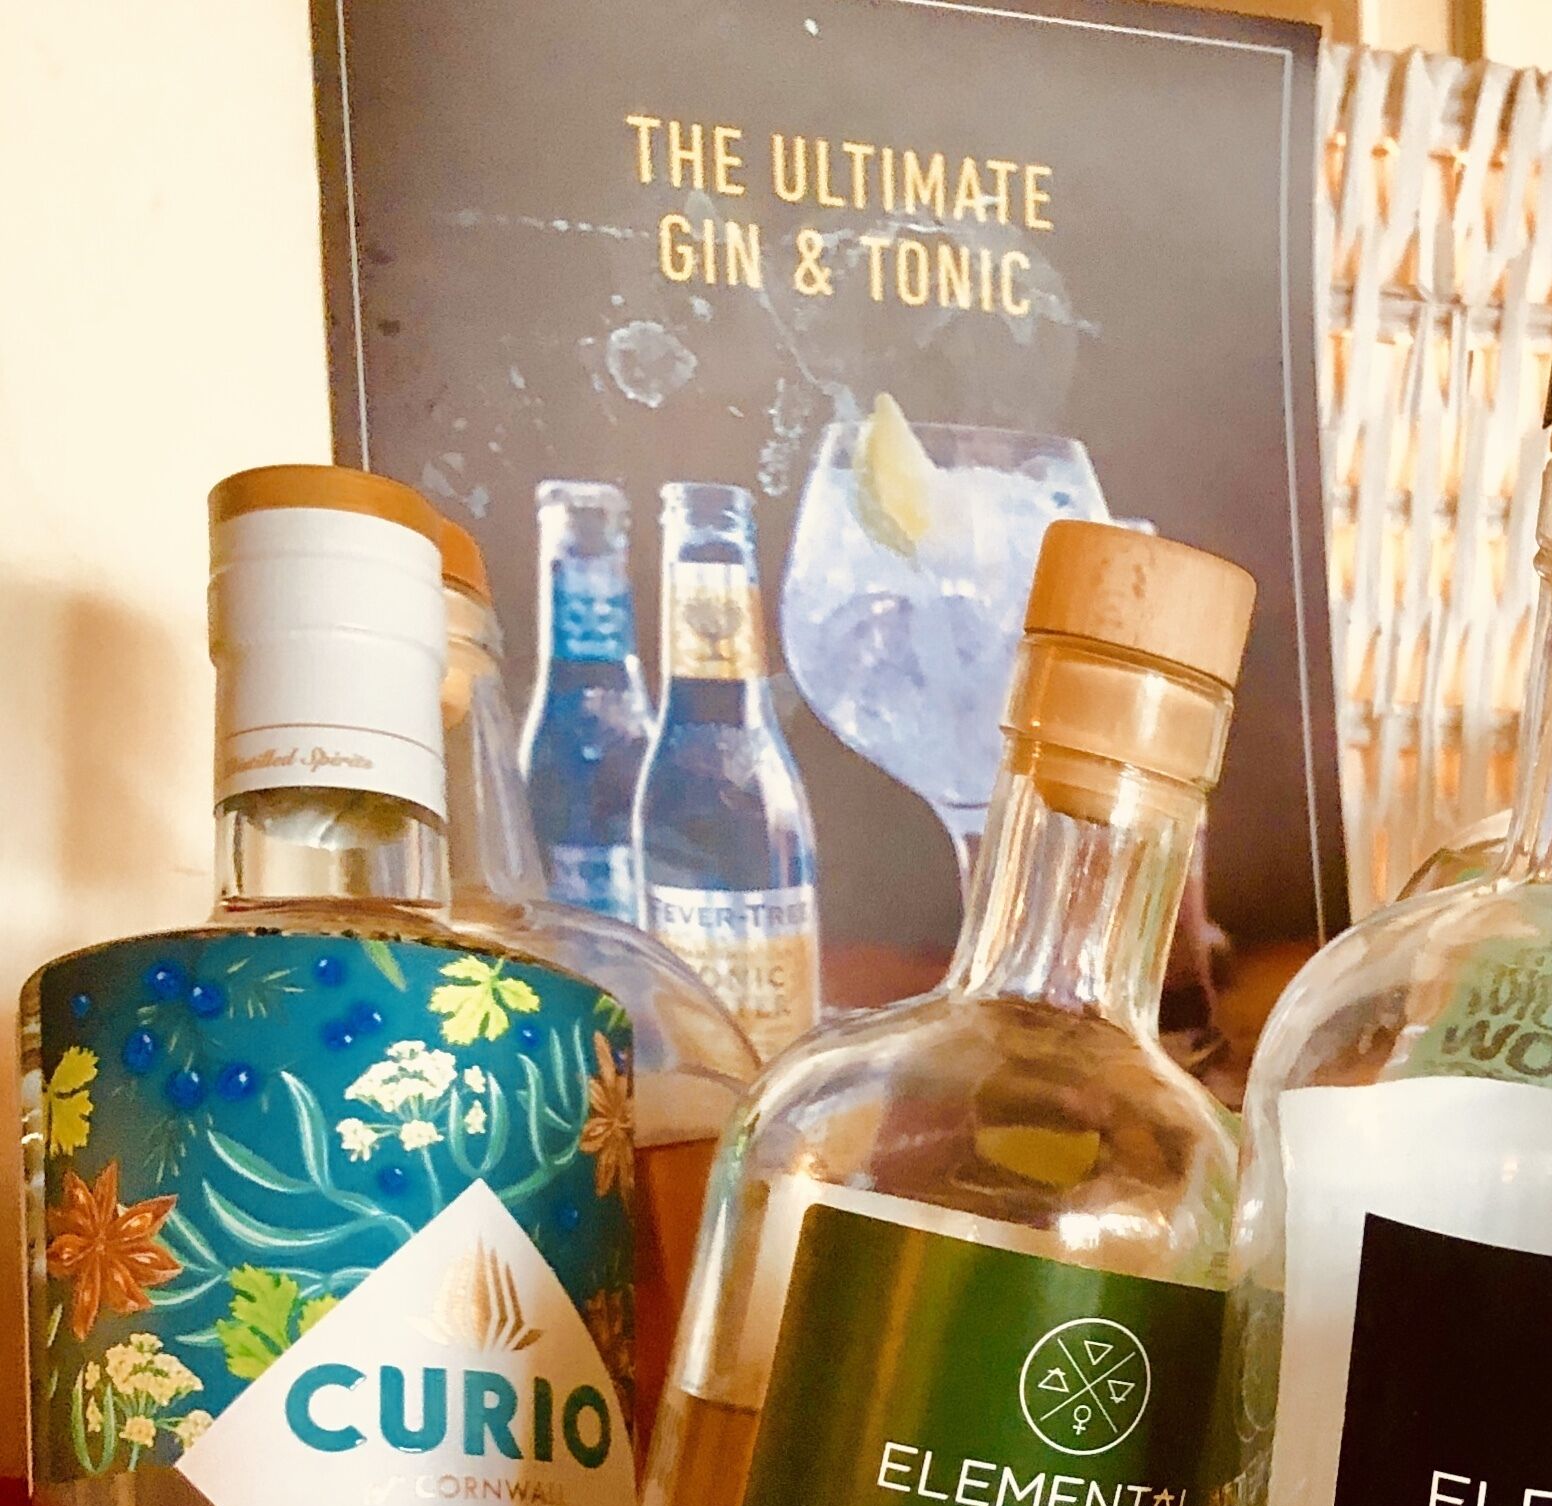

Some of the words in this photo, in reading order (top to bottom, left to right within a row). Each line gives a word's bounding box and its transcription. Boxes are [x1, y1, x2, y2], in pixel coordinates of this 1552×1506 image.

[626, 114, 746, 196] THE
[771, 132, 1055, 232] ULTIMATE
[657, 213, 764, 290] GIN
[793, 228, 833, 297] &
[859, 234, 1033, 317] TONIC
[300, 745, 374, 774] Spirits
[699, 965, 785, 989] ONIC
[284, 1362, 612, 1470] CURIO
